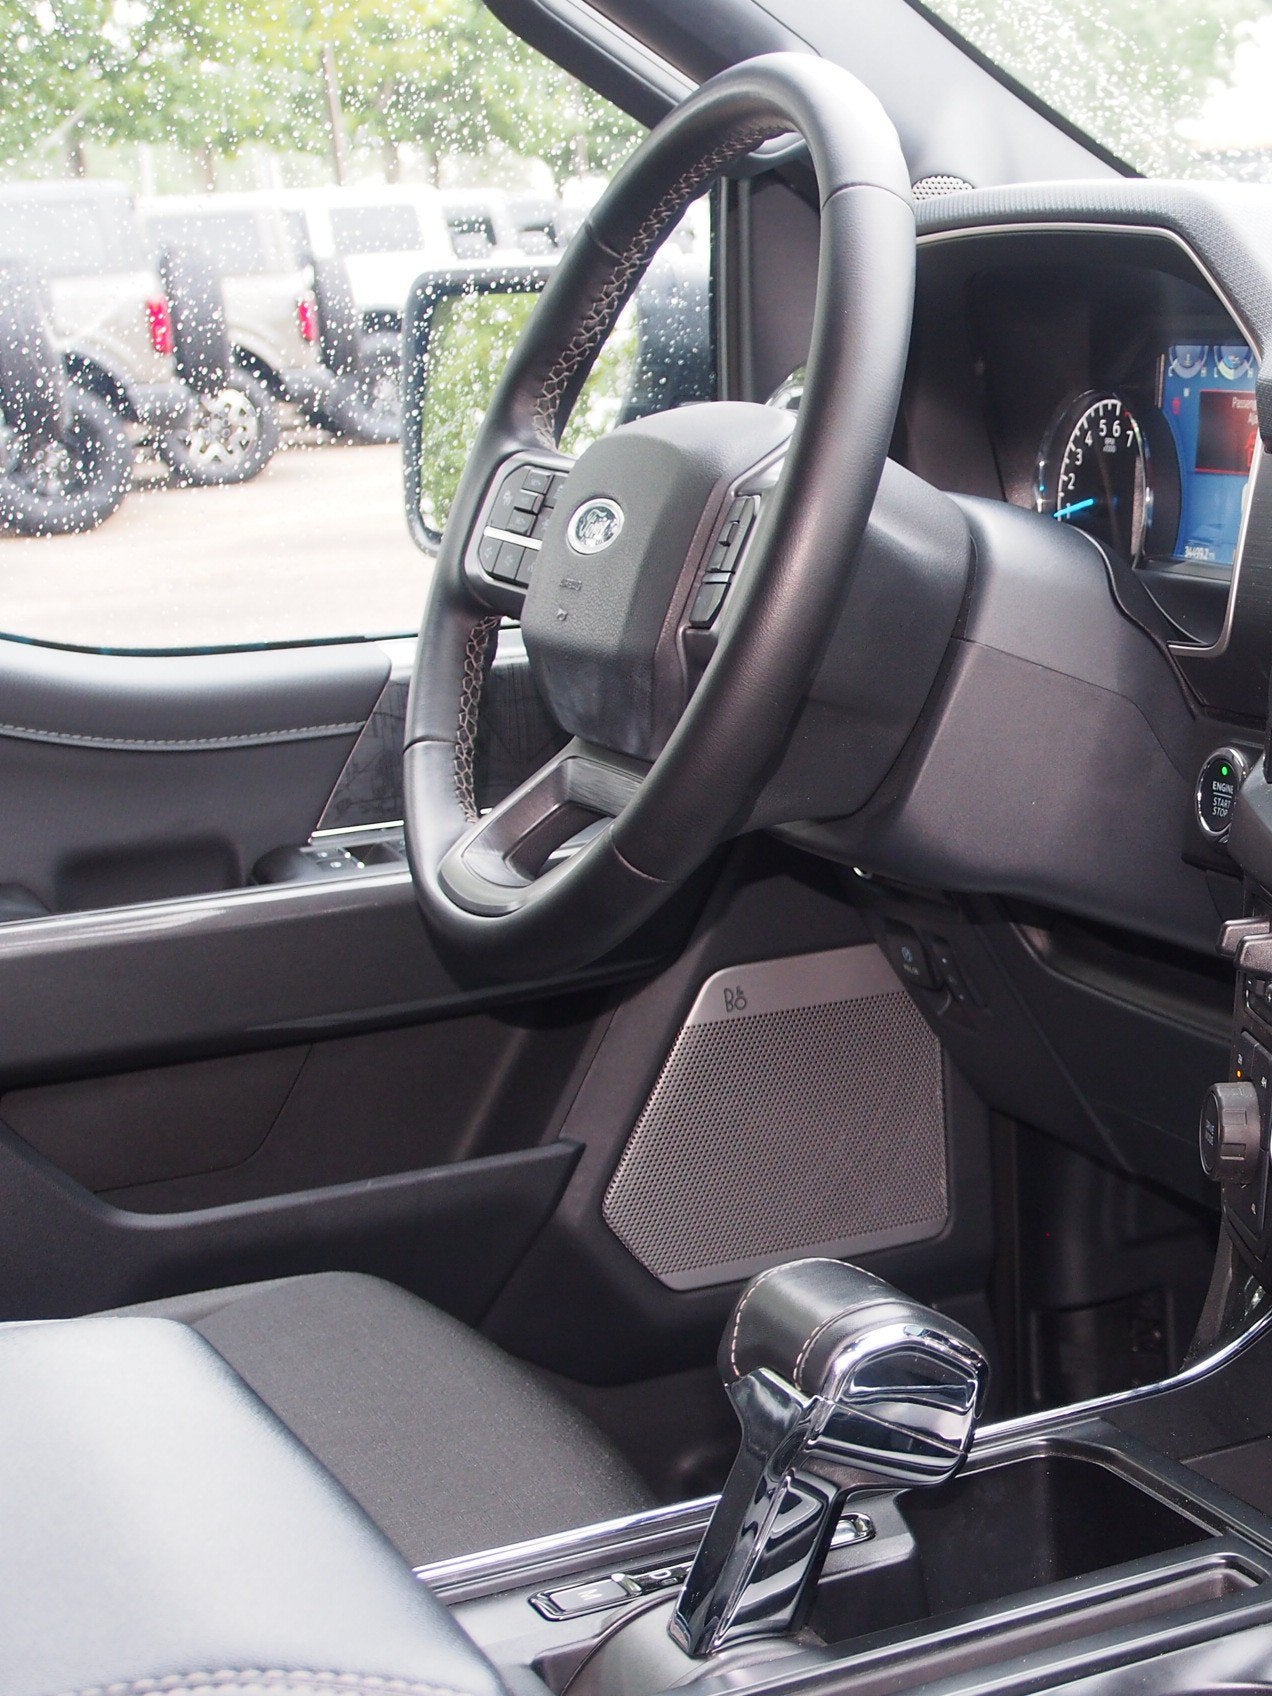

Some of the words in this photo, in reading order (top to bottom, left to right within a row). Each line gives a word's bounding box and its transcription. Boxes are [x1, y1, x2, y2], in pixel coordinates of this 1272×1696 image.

[1099, 419, 1108, 437] 5
[1112, 420, 1121, 438] 6
[1084, 430, 1093, 447] 4
[1125, 430, 1134, 448] 7
[1074, 448, 1083, 466] 3
[1067, 472, 1076, 491] 2
[1212, 781, 1234, 794] ENGINE
[1212, 797, 1231, 809] START
[1212, 807, 1229, 818] STOP
